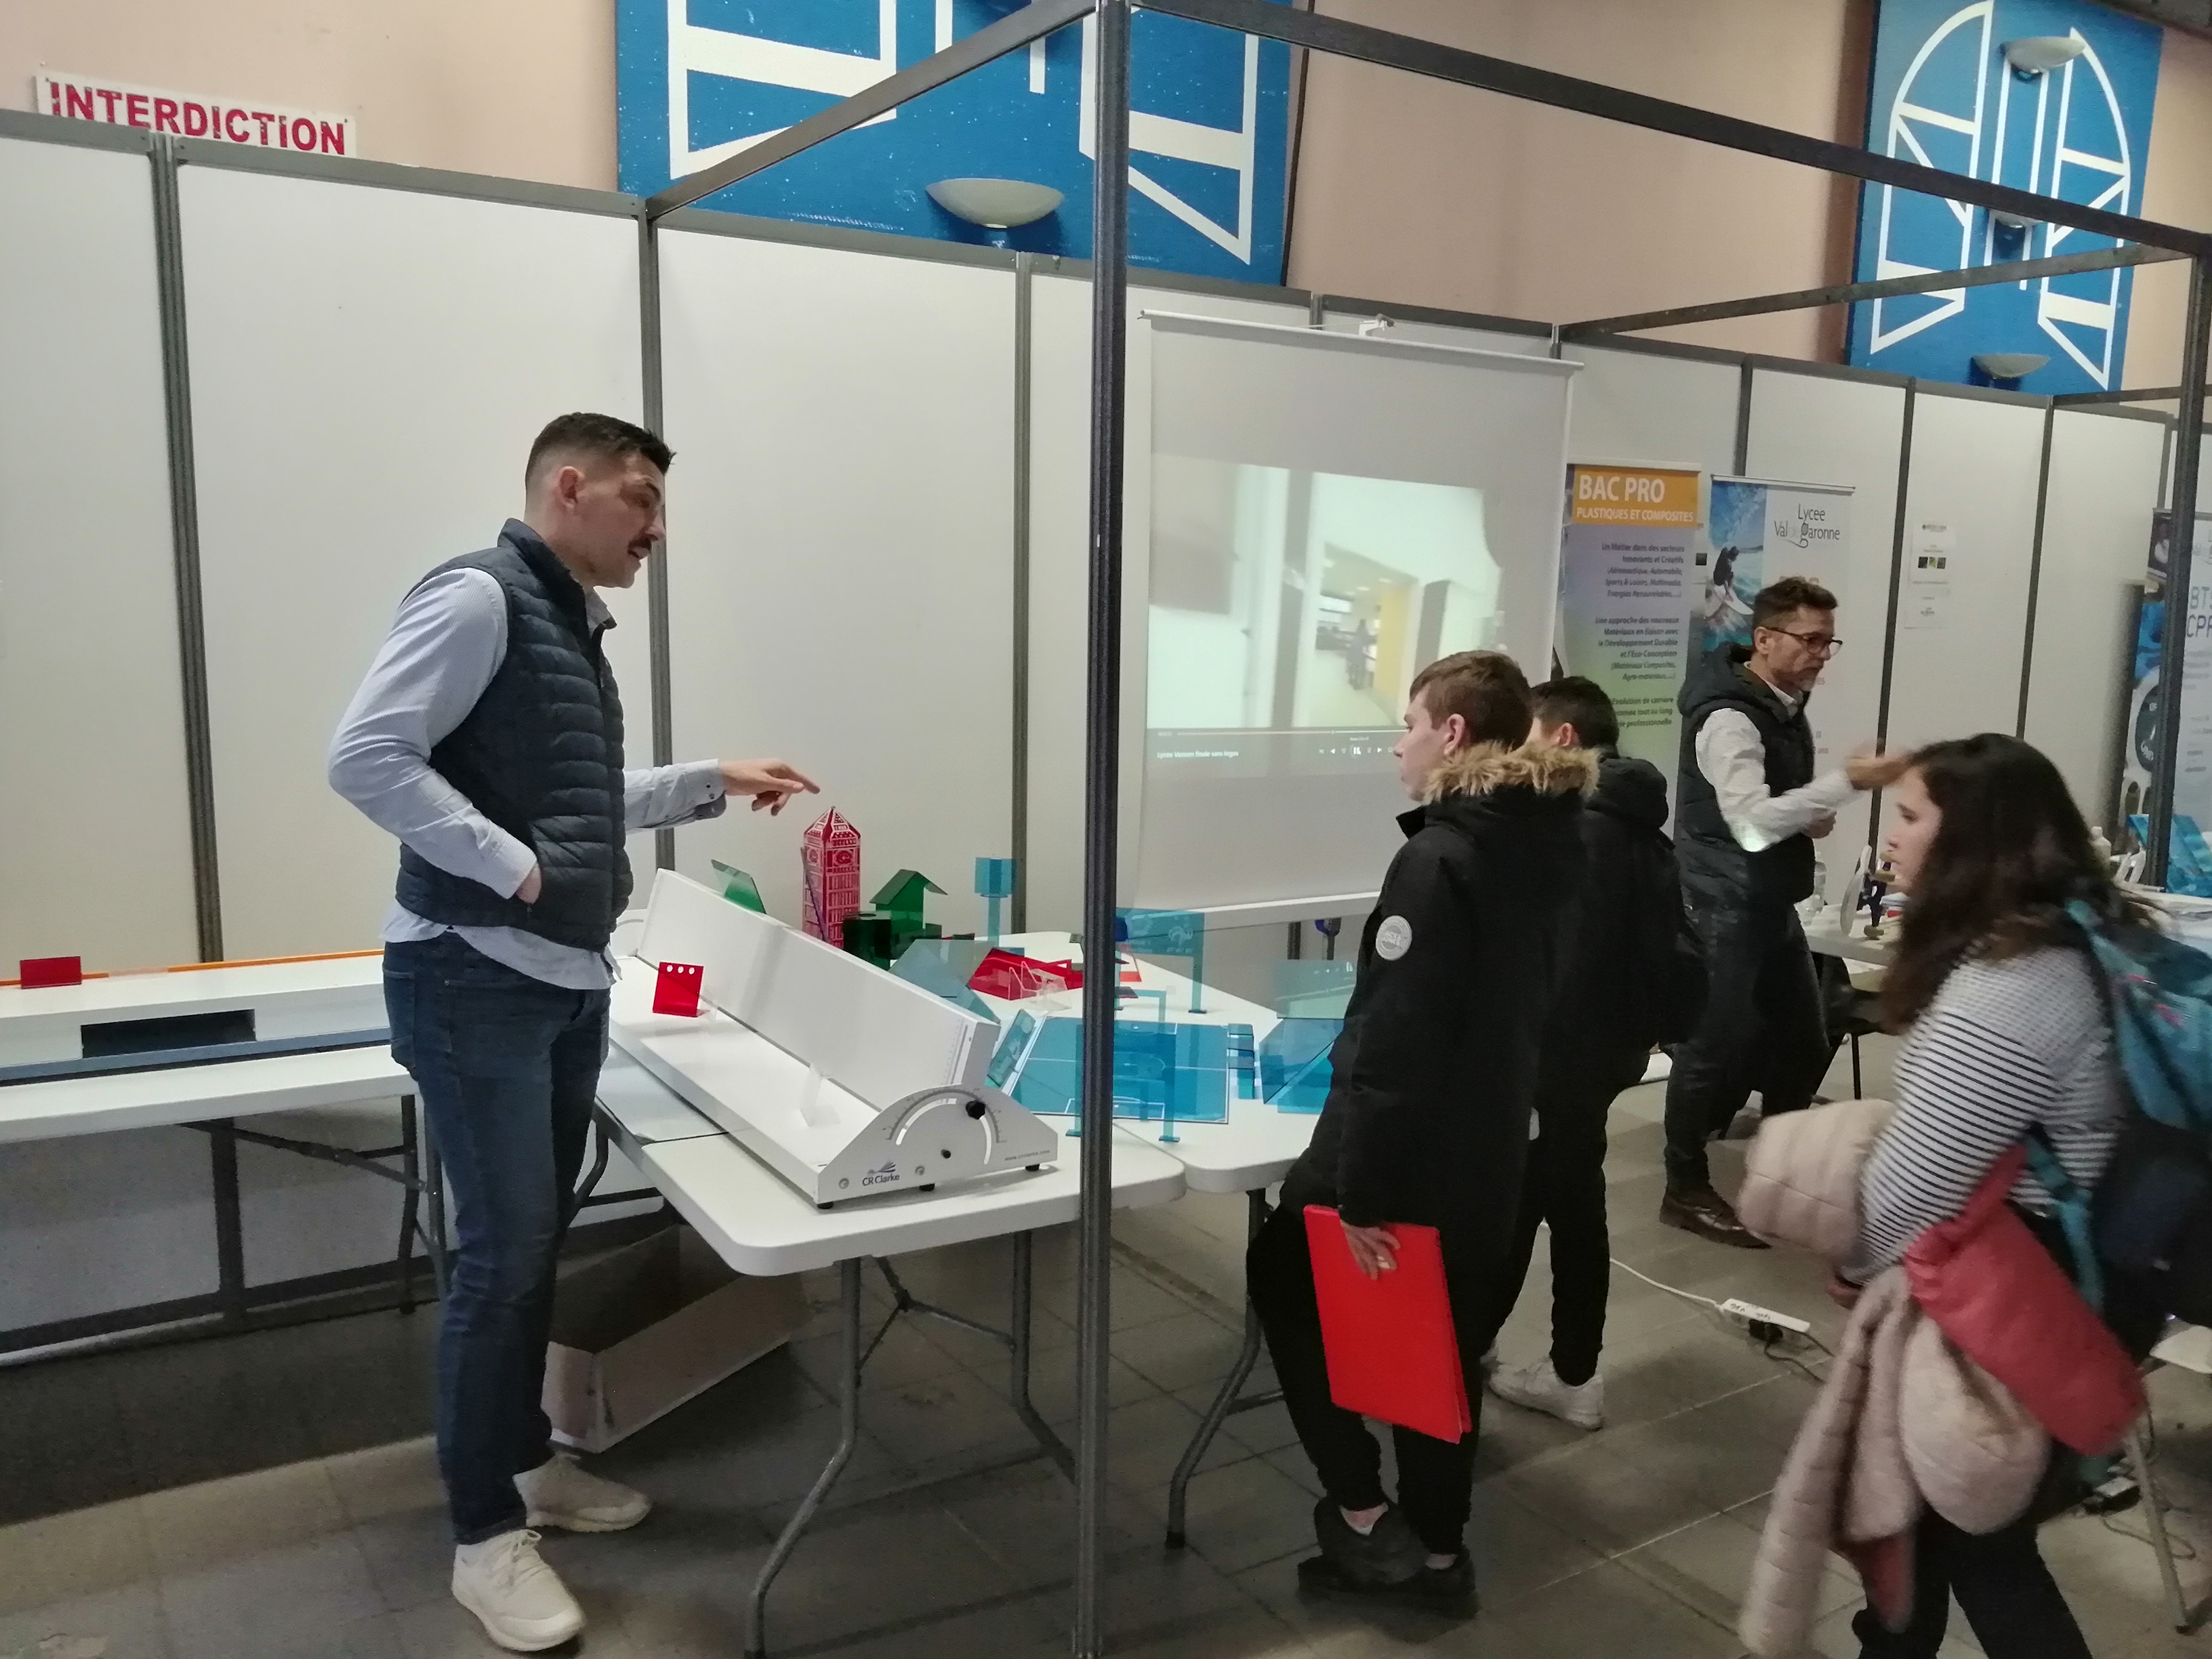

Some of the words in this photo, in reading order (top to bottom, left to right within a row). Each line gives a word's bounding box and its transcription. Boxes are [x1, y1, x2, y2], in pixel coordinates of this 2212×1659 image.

[50, 81, 345, 156] INTERDICTION
[1578, 474, 1620, 501] BAC
[1624, 476, 1666, 504] PRO
[1576, 507, 1628, 520] PLASTIQUES
[1630, 510, 1640, 520] ET
[1641, 510, 1694, 523] COMPOSITES
[1774, 520, 1788, 537] Val
[1601, 543, 1610, 551] Un
[1648, 544, 1659, 552] des
[1622, 555, 1653, 563] Innovants
[2190, 586, 2212, 609] BT
[1607, 617, 1638, 625] approche
[1638, 616, 1650, 624] des
[1603, 628, 1635, 636] Matériaux
[1654, 638, 1679, 647] Durable
[1658, 708, 1673, 716] long
[1626, 718, 1673, 729] professionnelle
[862, 1177, 874, 1186] CR
[874, 1173, 901, 1184] Clarke
